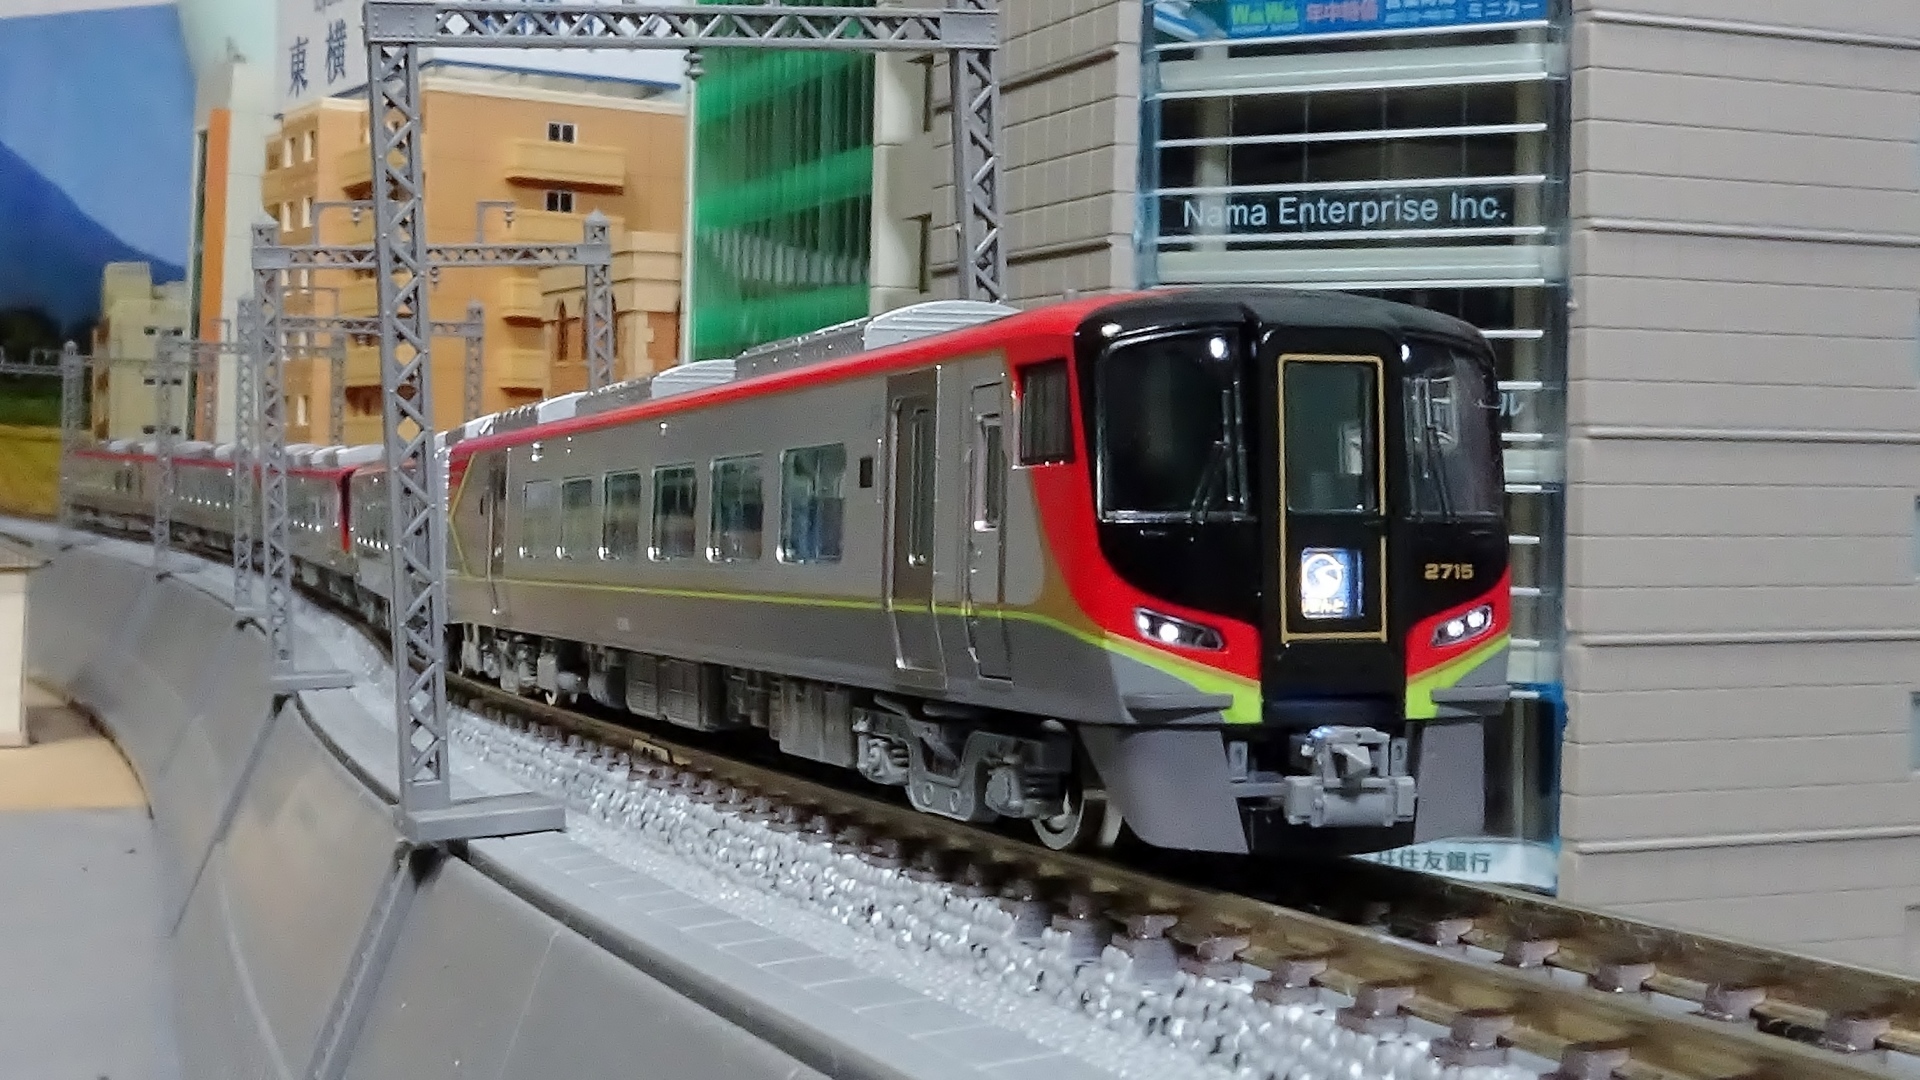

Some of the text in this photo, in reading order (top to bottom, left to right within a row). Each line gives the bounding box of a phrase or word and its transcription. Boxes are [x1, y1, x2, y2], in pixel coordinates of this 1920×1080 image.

[1182, 192, 1507, 228] Nama Enterprise Inc.
[1424, 563, 1475, 580] 2715
